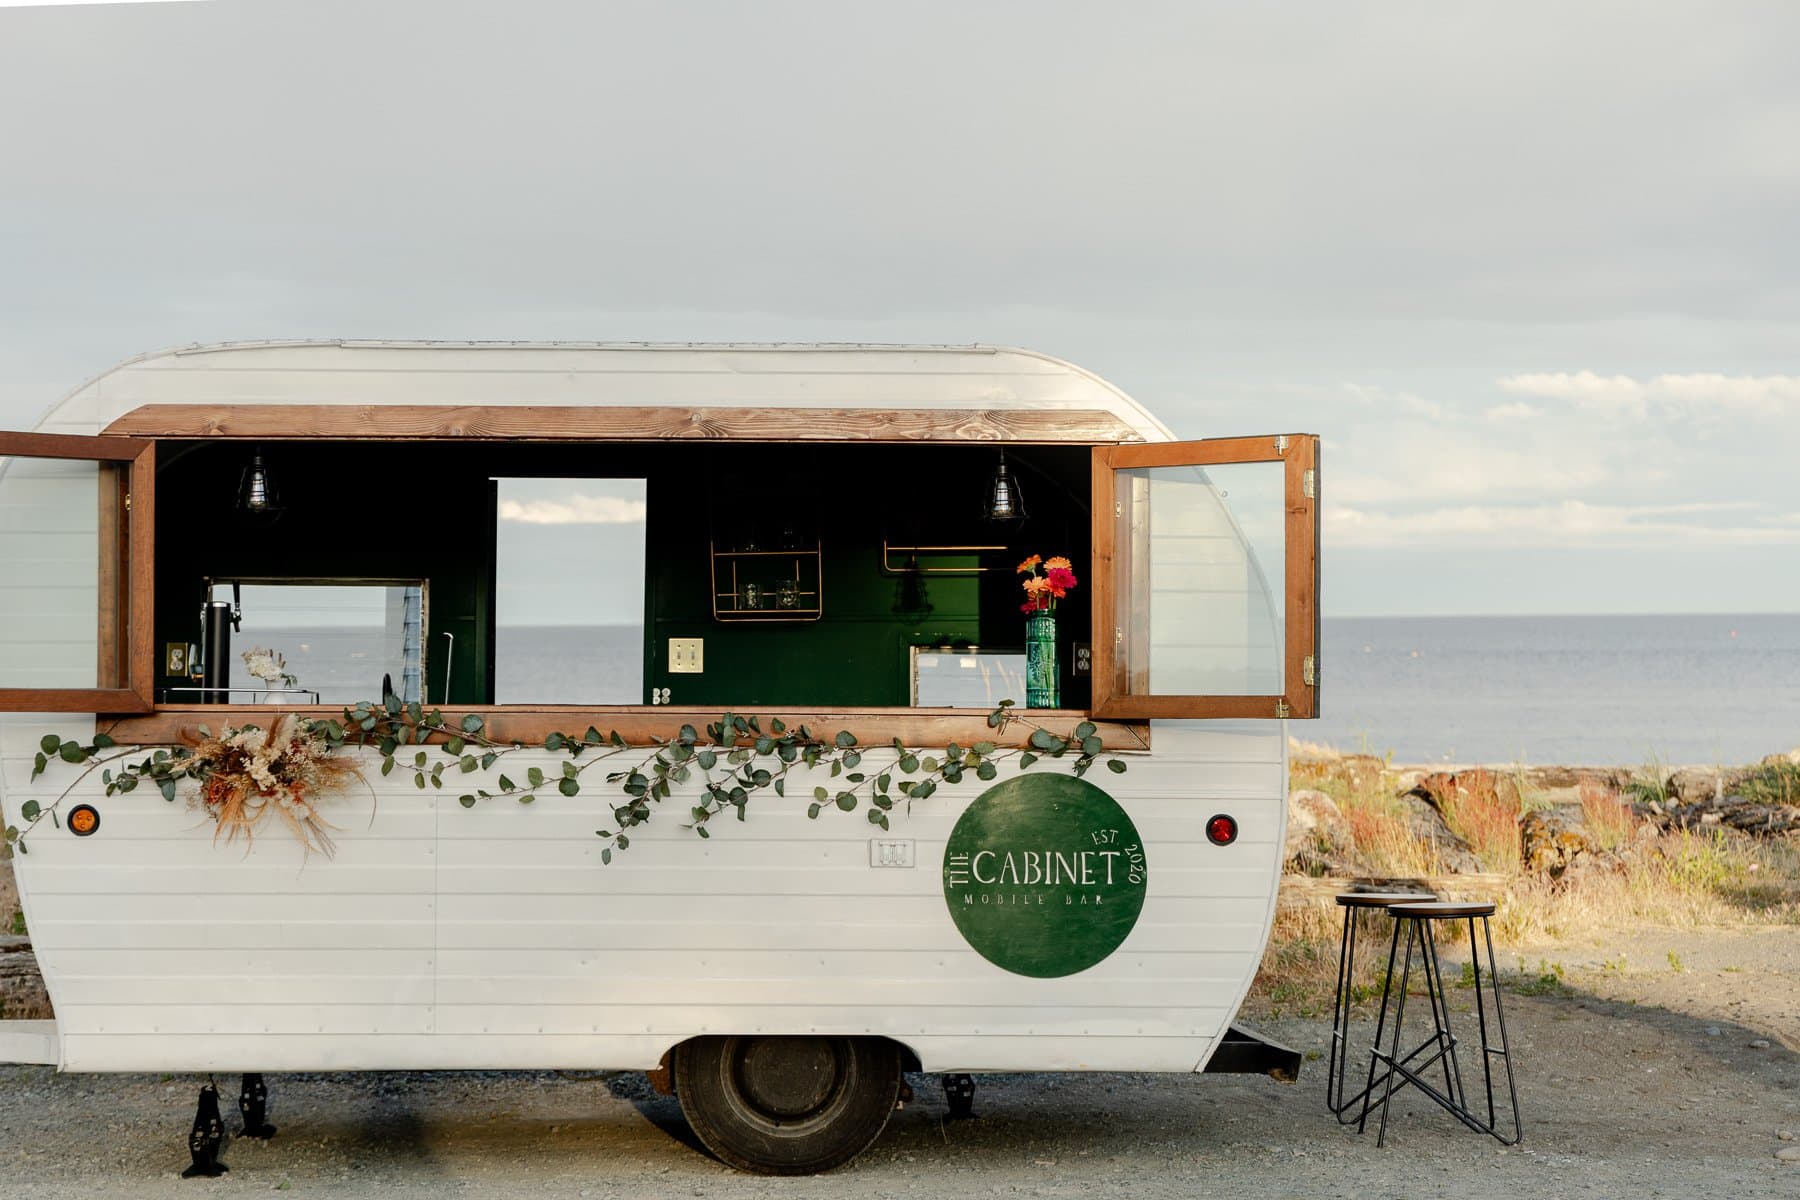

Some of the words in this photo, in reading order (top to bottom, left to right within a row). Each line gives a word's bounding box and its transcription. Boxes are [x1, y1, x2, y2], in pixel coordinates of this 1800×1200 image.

[949, 852, 969, 889] THE
[972, 850, 1121, 885] CABINET
[1124, 844, 1144, 884] 2020
[963, 894, 1045, 905] MOBILE
[1065, 894, 1103, 905] BAR
